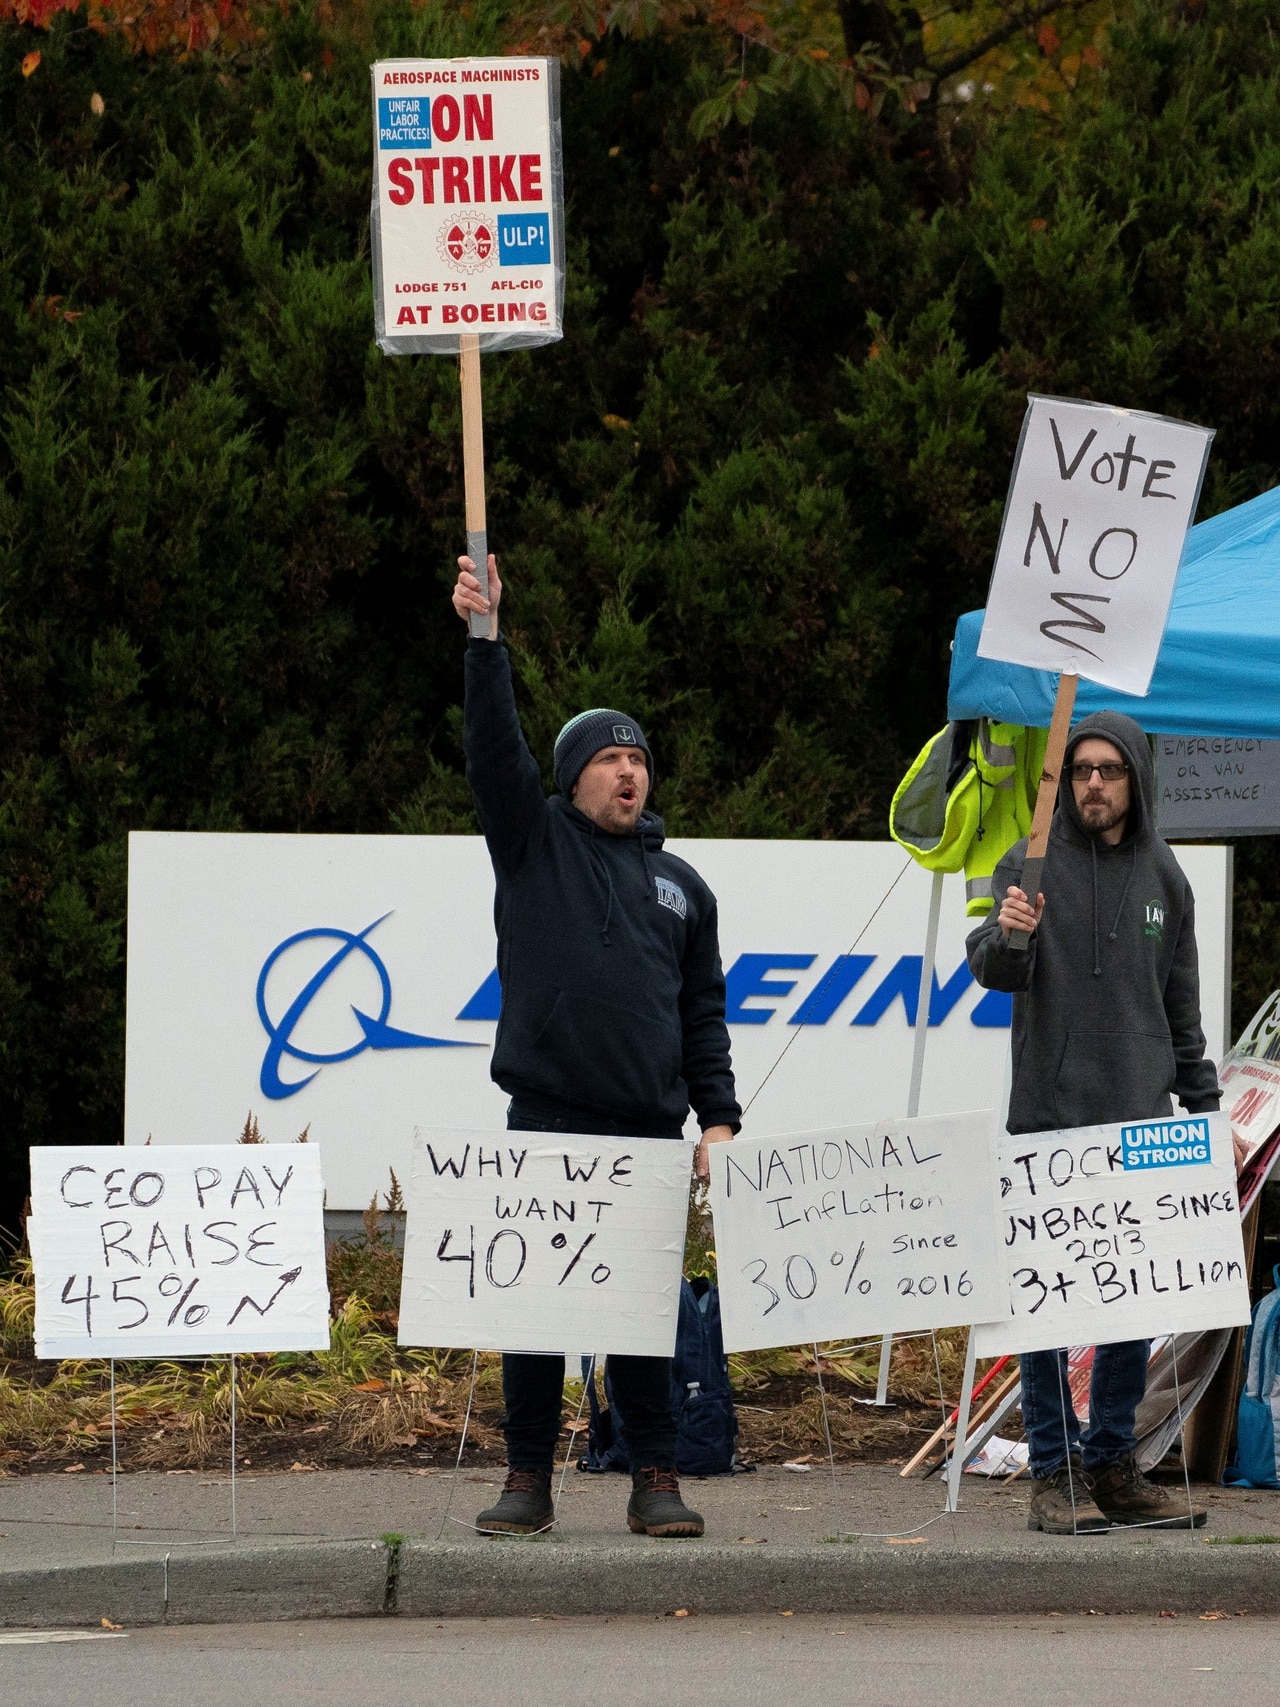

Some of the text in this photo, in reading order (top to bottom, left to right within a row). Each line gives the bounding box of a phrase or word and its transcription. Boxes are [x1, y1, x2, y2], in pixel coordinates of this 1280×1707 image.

[383, 69, 540, 85] AEROSPACE MACHINISTS
[388, 100, 420, 113] UNFAIR
[390, 114, 419, 127] LABOR
[431, 94, 494, 142] ON
[380, 127, 430, 141] PRACTICES!
[387, 154, 543, 206] STRIKE
[503, 226, 544, 247] ULP!
[395, 279, 543, 293] LODGE 751 AFL-CIO
[396, 302, 547, 325] AT BOEING
[1024, 501, 1138, 581] NO
[1164, 738, 1264, 756] EMERGENCY
[1177, 762, 1245, 778] OR VAN
[1125, 1122, 1206, 1148] UNION
[426, 1143, 634, 1187] WHY WE
[726, 1135, 942, 1198] NATIONAL
[1127, 1144, 1207, 1166] STRONG
[60, 1164, 294, 1210] CEO PAY
[495, 1195, 613, 1223] WANT
[1156, 1190, 1235, 1220] SINCE
[100, 1220, 284, 1269] RAISE
[1066, 1230, 1146, 1263] 2013
[436, 1225, 611, 1298] 40%
[741, 1241, 872, 1317] 30%
[896, 1270, 974, 1297] 2016
[61, 1272, 210, 1338] 45%
